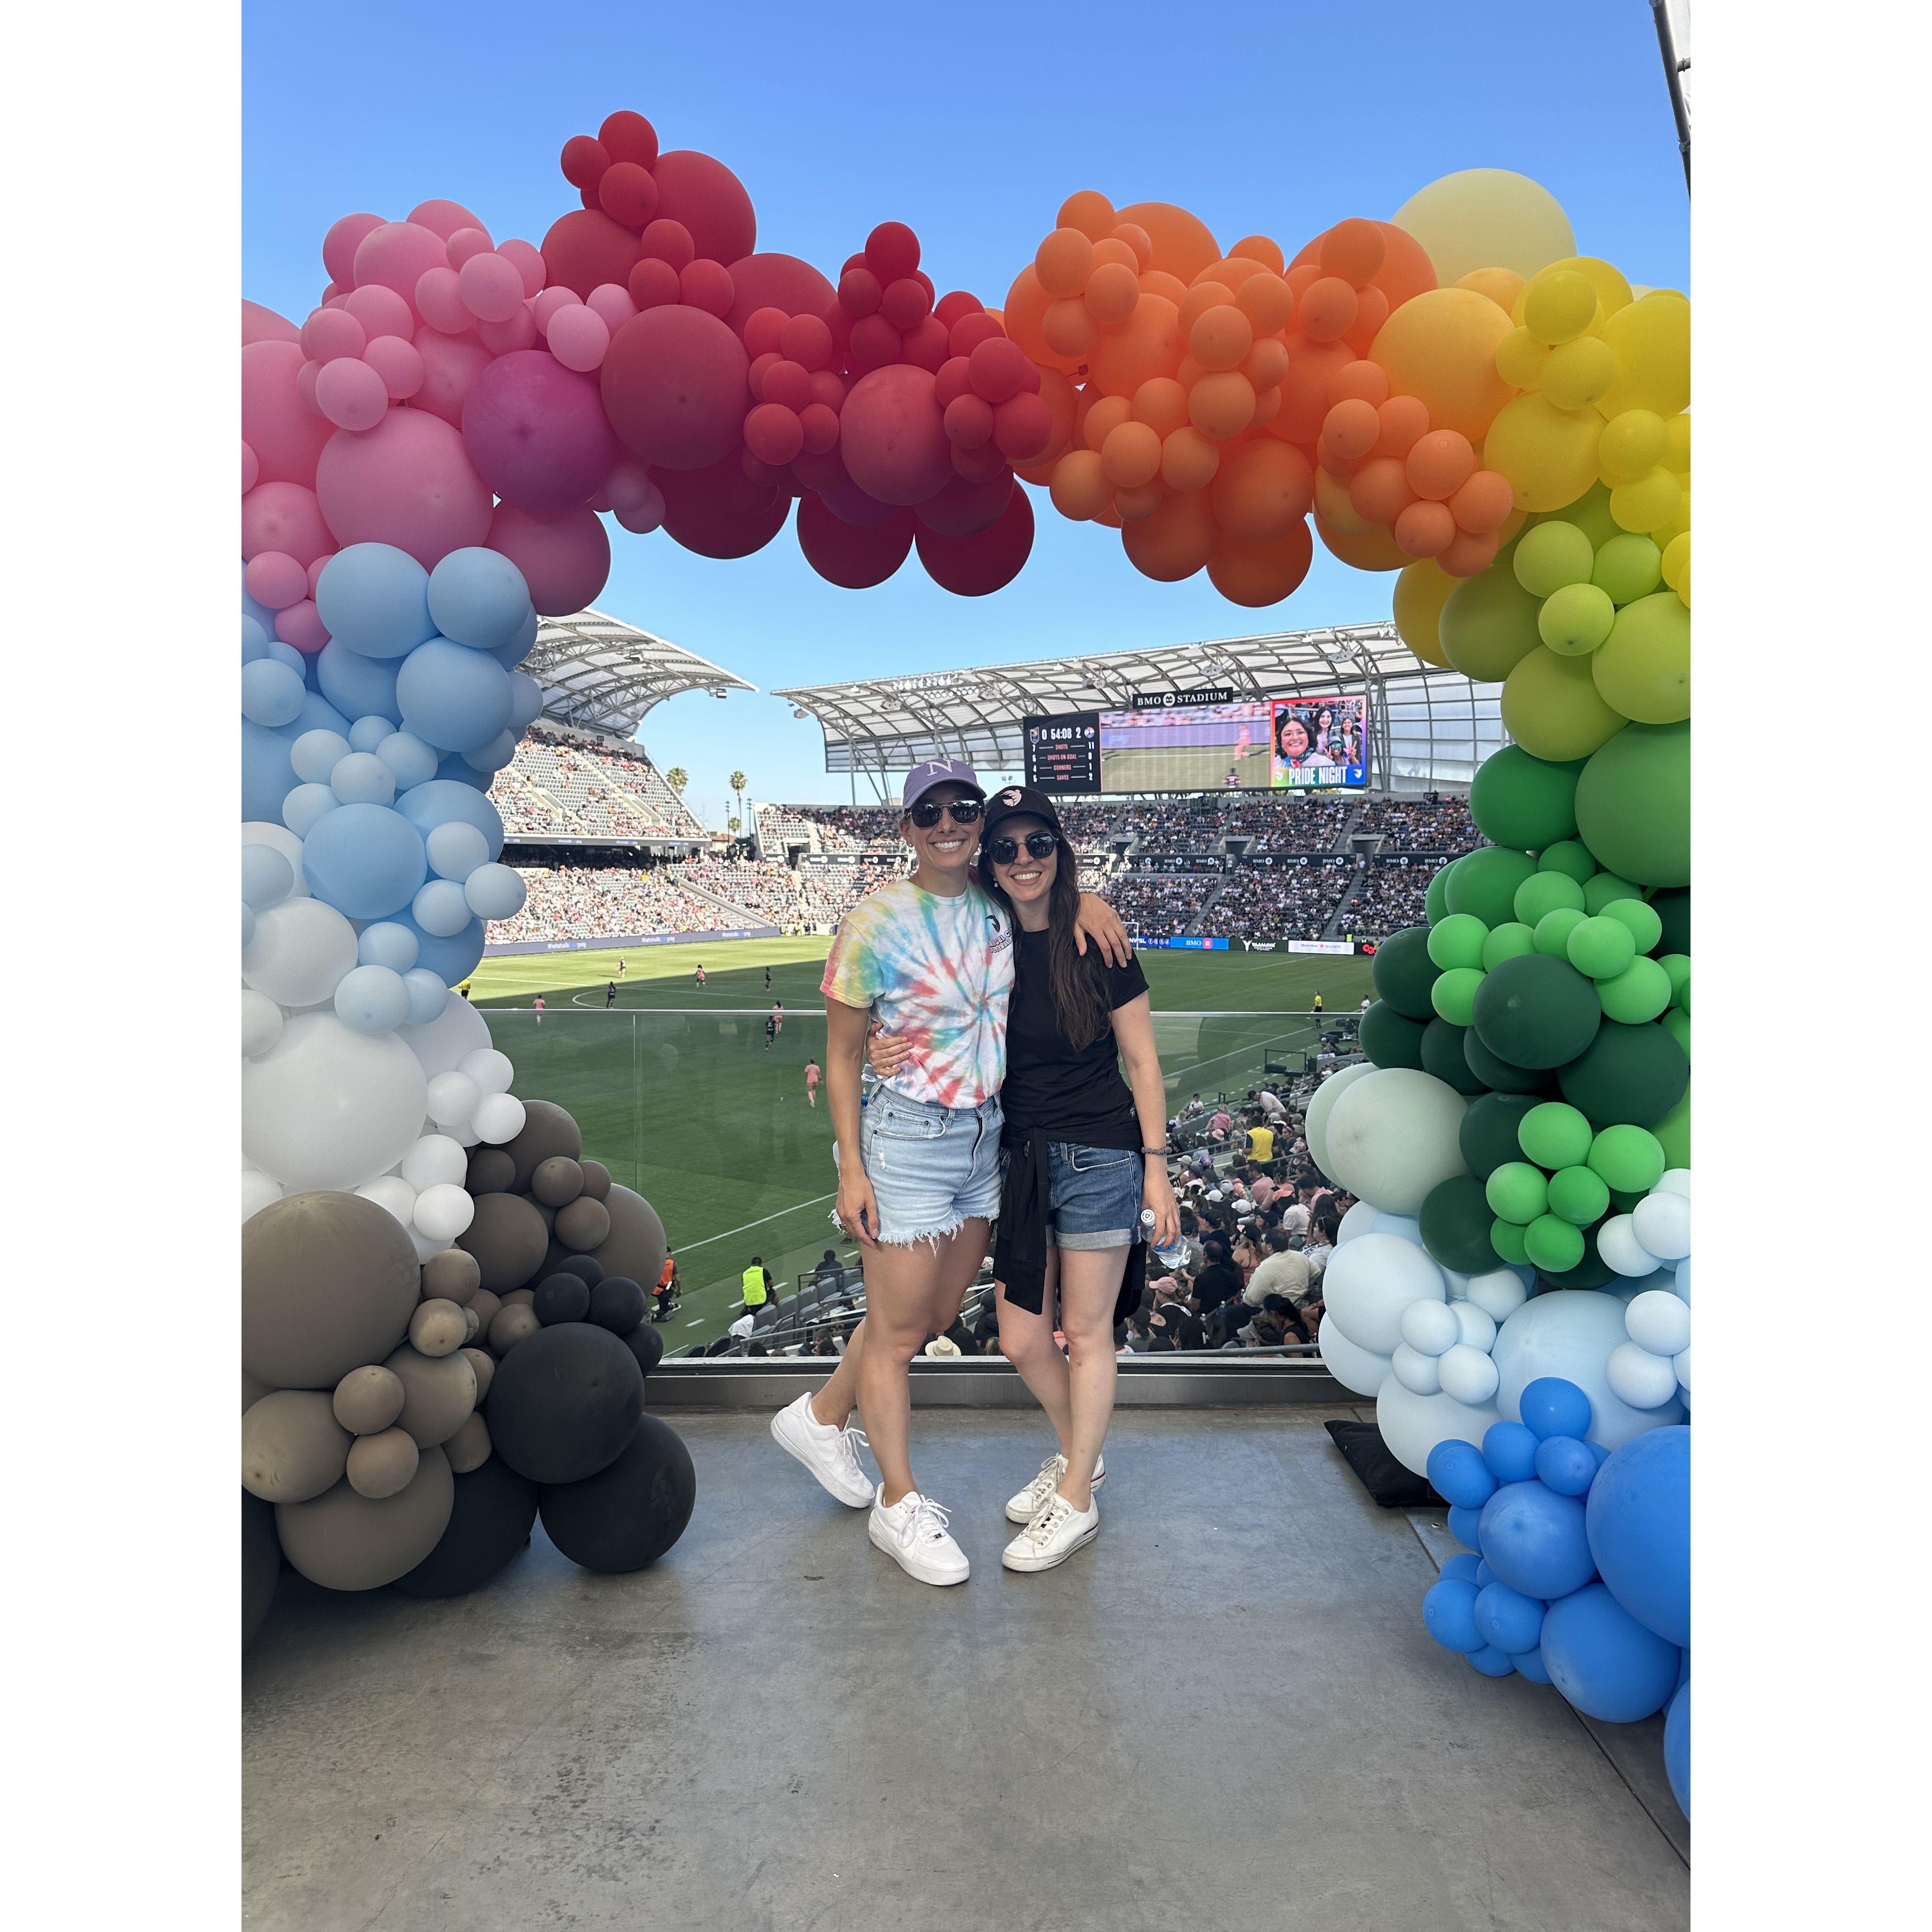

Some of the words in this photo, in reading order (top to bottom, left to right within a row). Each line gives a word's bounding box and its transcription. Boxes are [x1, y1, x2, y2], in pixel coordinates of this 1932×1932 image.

[1137, 697, 1162, 706] BMO
[1177, 691, 1228, 703] STADIUM
[1041, 729, 1047, 740] 0
[1076, 727, 1081, 738] 2
[1088, 741, 1094, 749] 11
[926, 758, 954, 776] N
[1089, 762, 1092, 770] 1
[1089, 772, 1093, 781] 2
[1288, 767, 1316, 785] PRIDE
[1319, 766, 1347, 784] NIGHT
[989, 935, 1006, 947] ANGEL
[989, 938, 1012, 954] FOOTBALL
